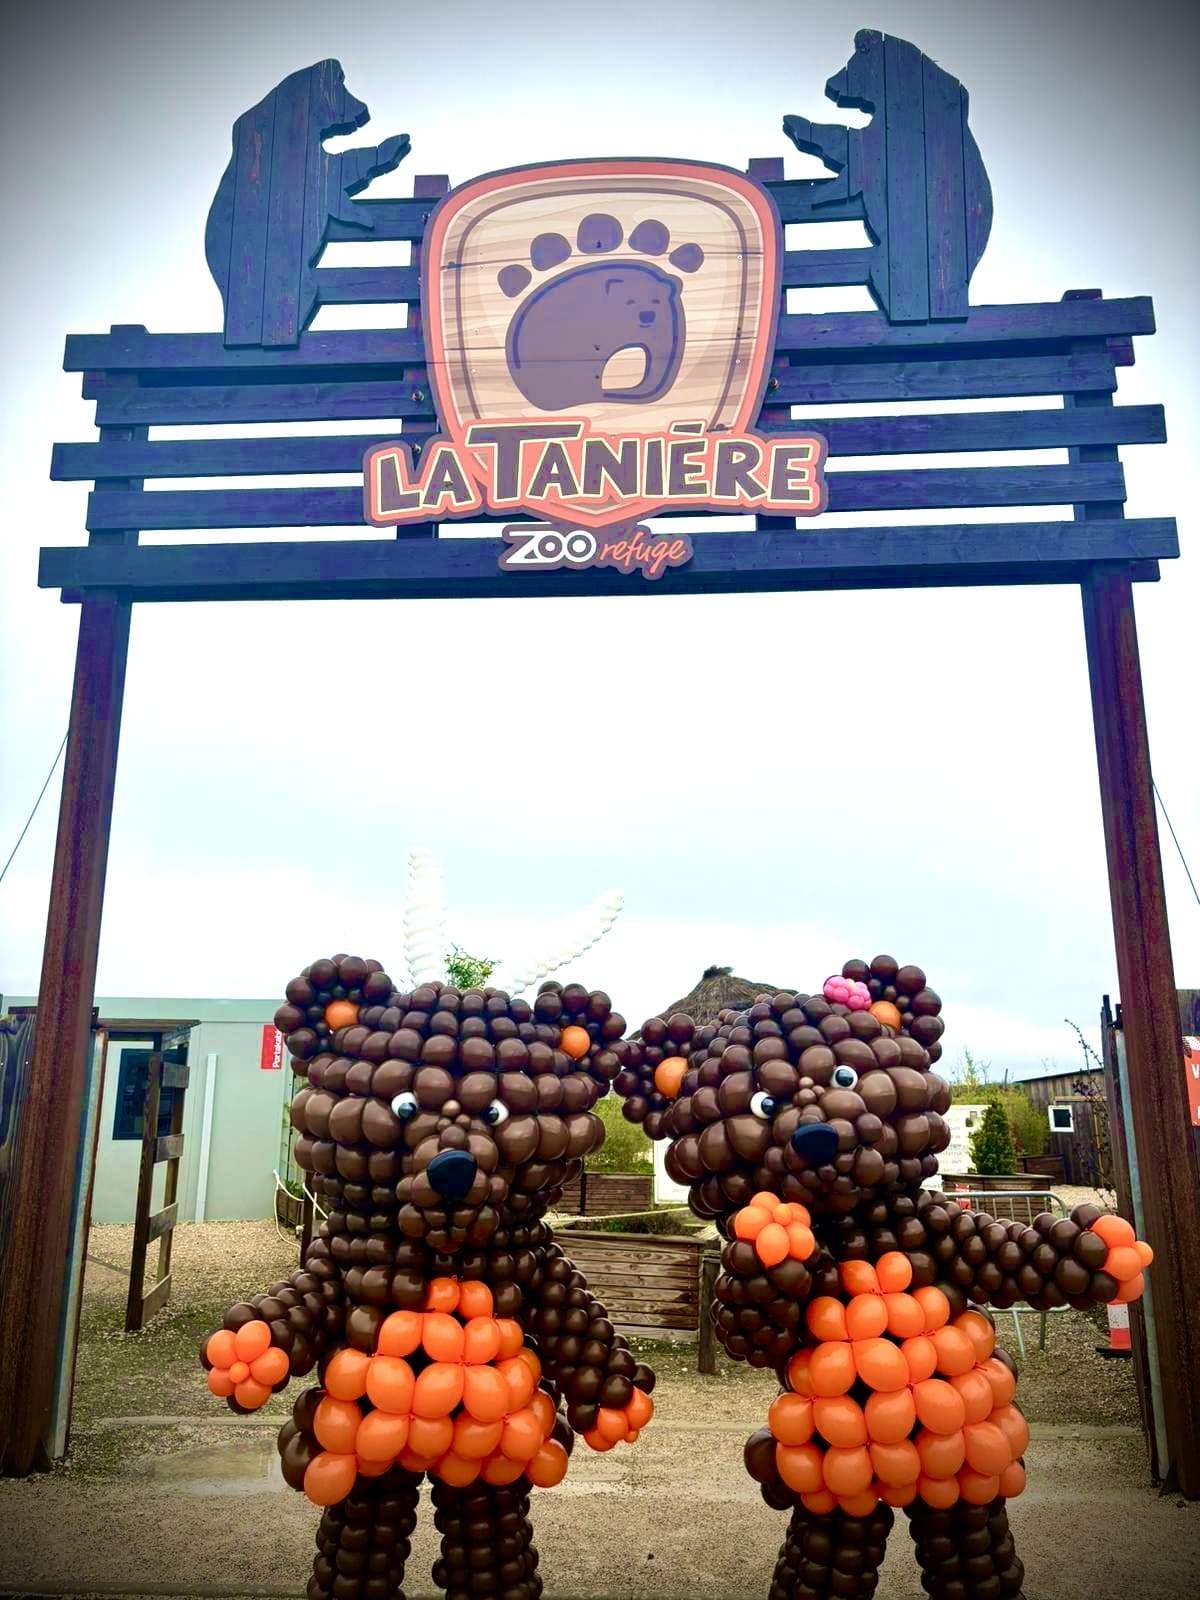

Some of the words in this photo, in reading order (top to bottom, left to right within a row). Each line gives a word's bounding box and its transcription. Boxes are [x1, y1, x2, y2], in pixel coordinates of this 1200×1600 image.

[377, 449, 473, 515] LA
[505, 530, 596, 564] ZOO
[599, 533, 686, 573] refuge
[272, 1028, 282, 1068] Portakabi
